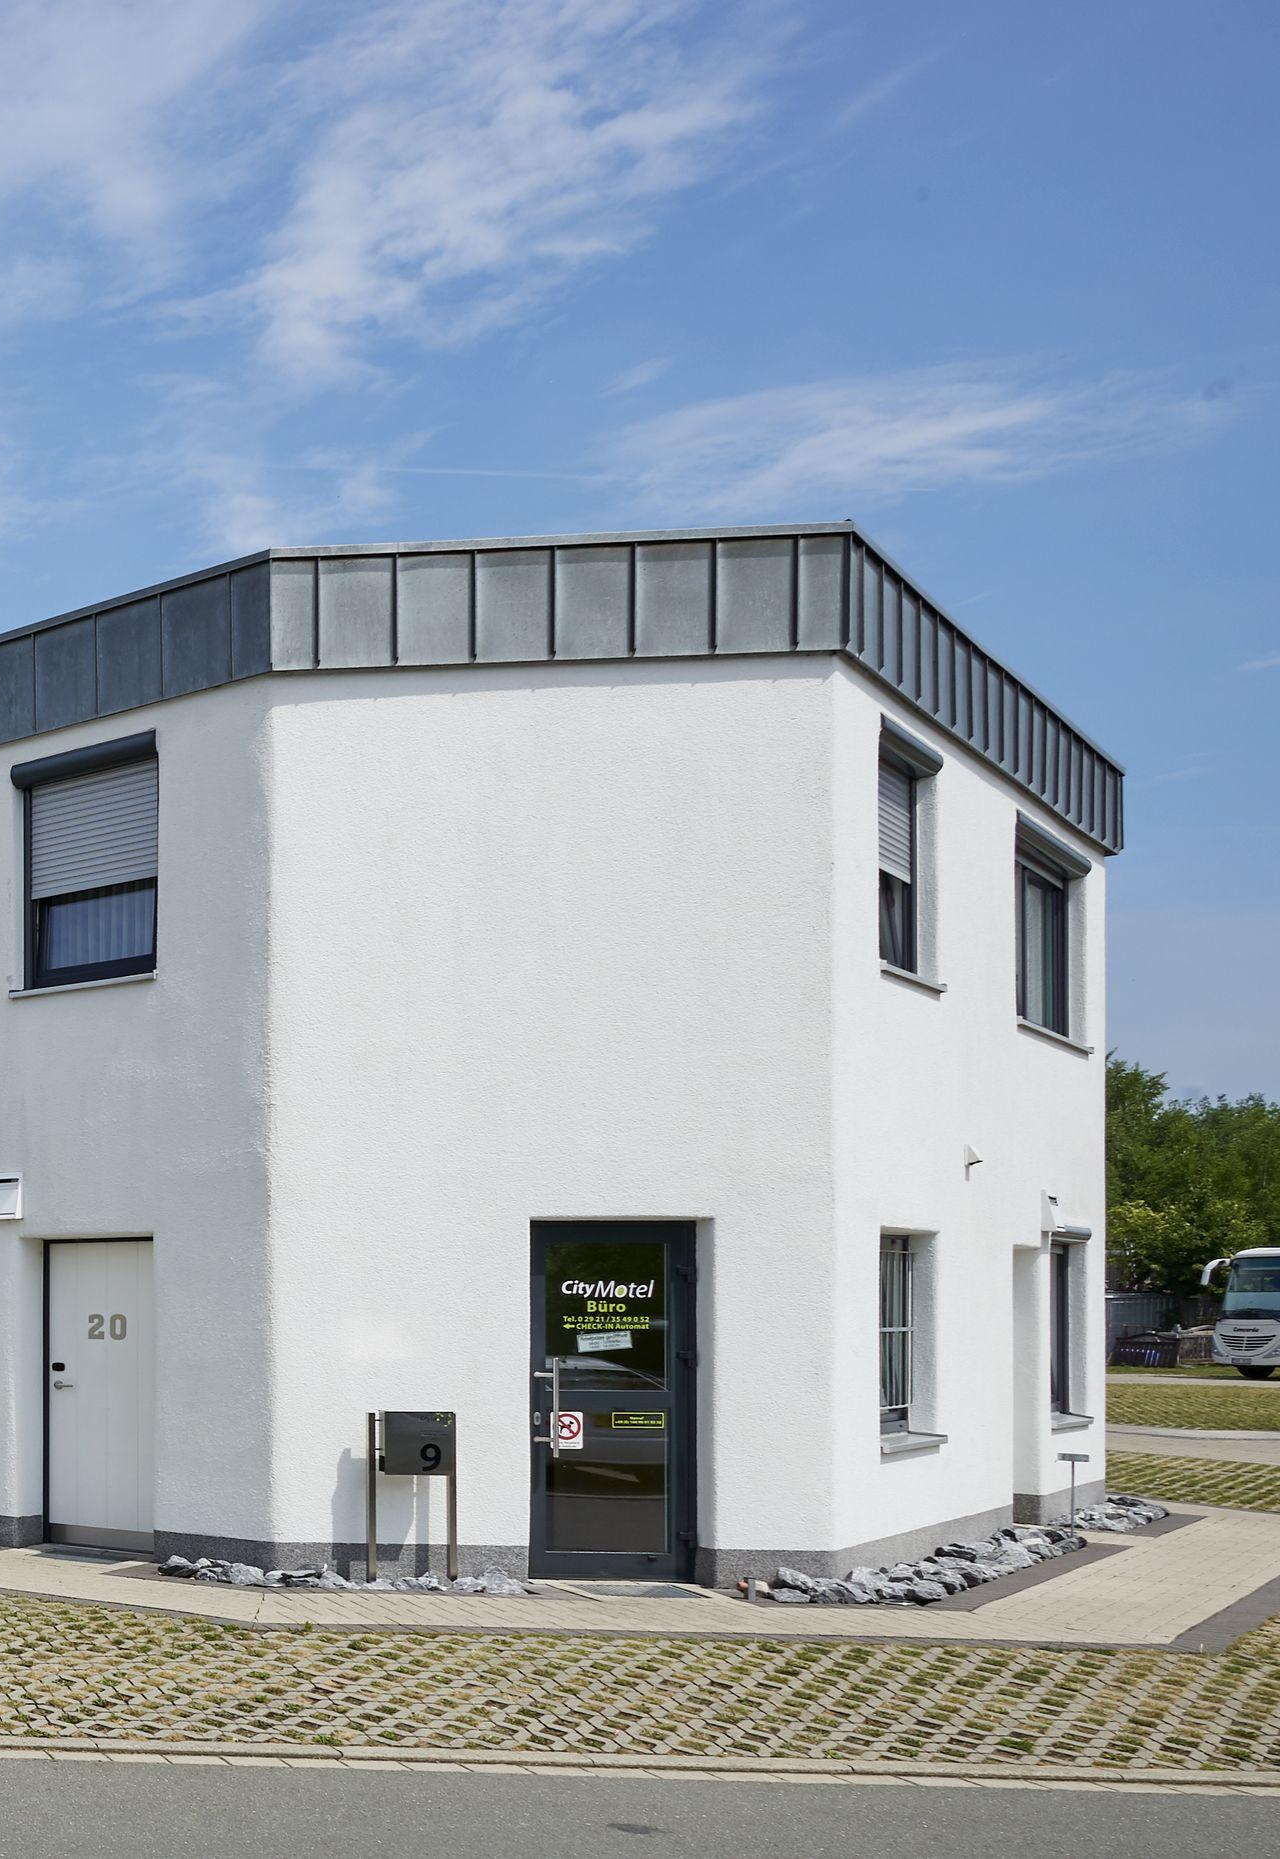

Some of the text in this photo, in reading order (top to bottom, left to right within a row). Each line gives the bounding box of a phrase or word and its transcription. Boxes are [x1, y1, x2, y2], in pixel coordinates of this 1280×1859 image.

[587, 1300, 626, 1313] Büro
[88, 1313, 127, 1340] 20
[562, 1315, 577, 1323] Tel.
[420, 1443, 442, 1472] 9
